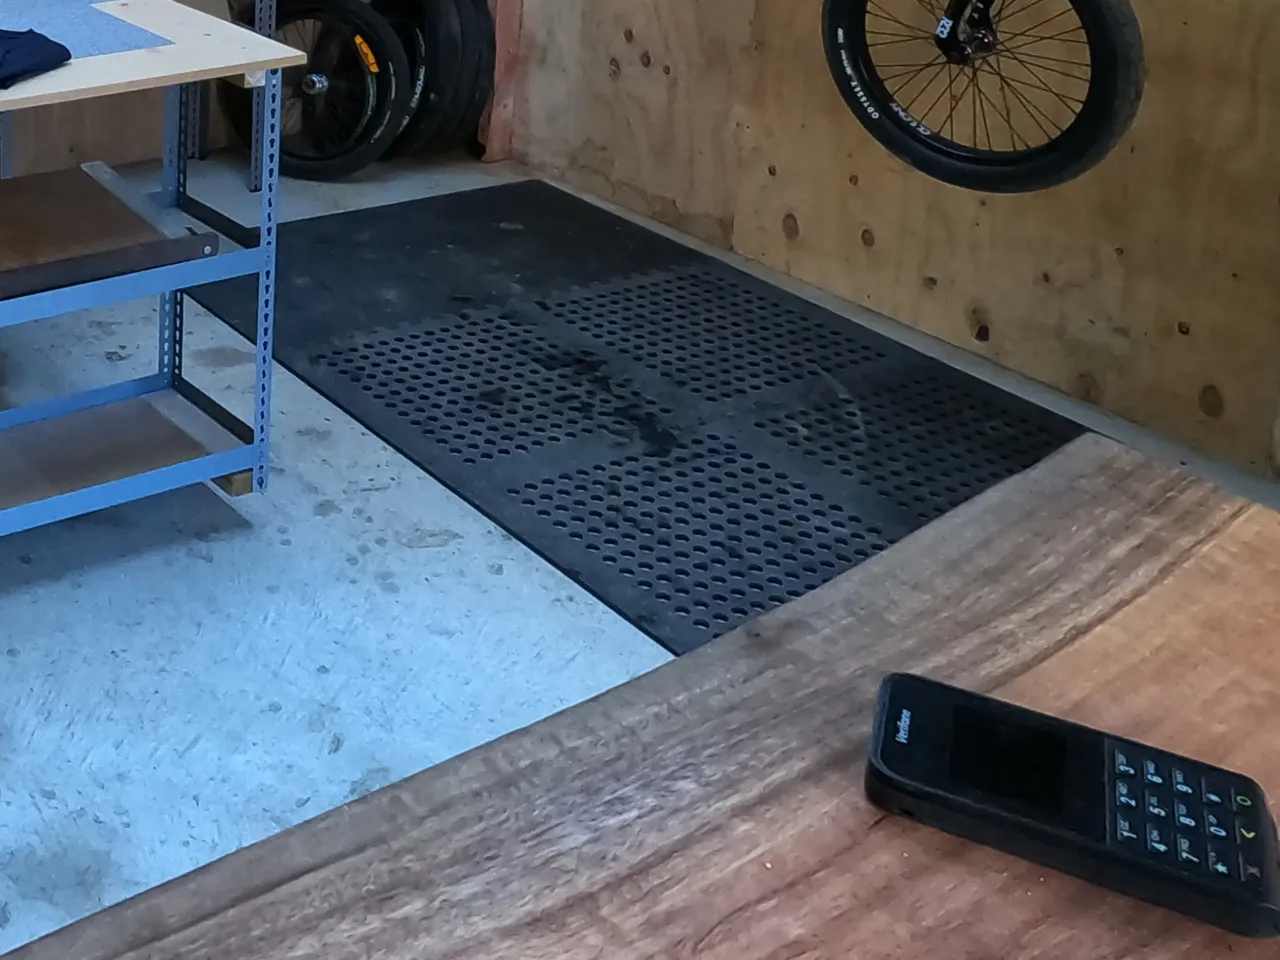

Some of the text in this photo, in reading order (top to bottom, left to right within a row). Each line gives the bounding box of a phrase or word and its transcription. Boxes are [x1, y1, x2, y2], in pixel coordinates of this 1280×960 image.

[850, 81, 879, 119] ODYSSEY
[895, 708, 911, 744] Verifone
[1119, 764, 1135, 775] 3
[1146, 773, 1163, 784] 6
[1176, 784, 1193, 793] 9
[1120, 796, 1136, 807] 2
[1149, 806, 1166, 817] 5
[1179, 816, 1196, 827] 8
[1122, 830, 1138, 839] 1
[1209, 826, 1227, 837] 0
[1151, 842, 1169, 852] 4
[1181, 851, 1200, 863] 7
